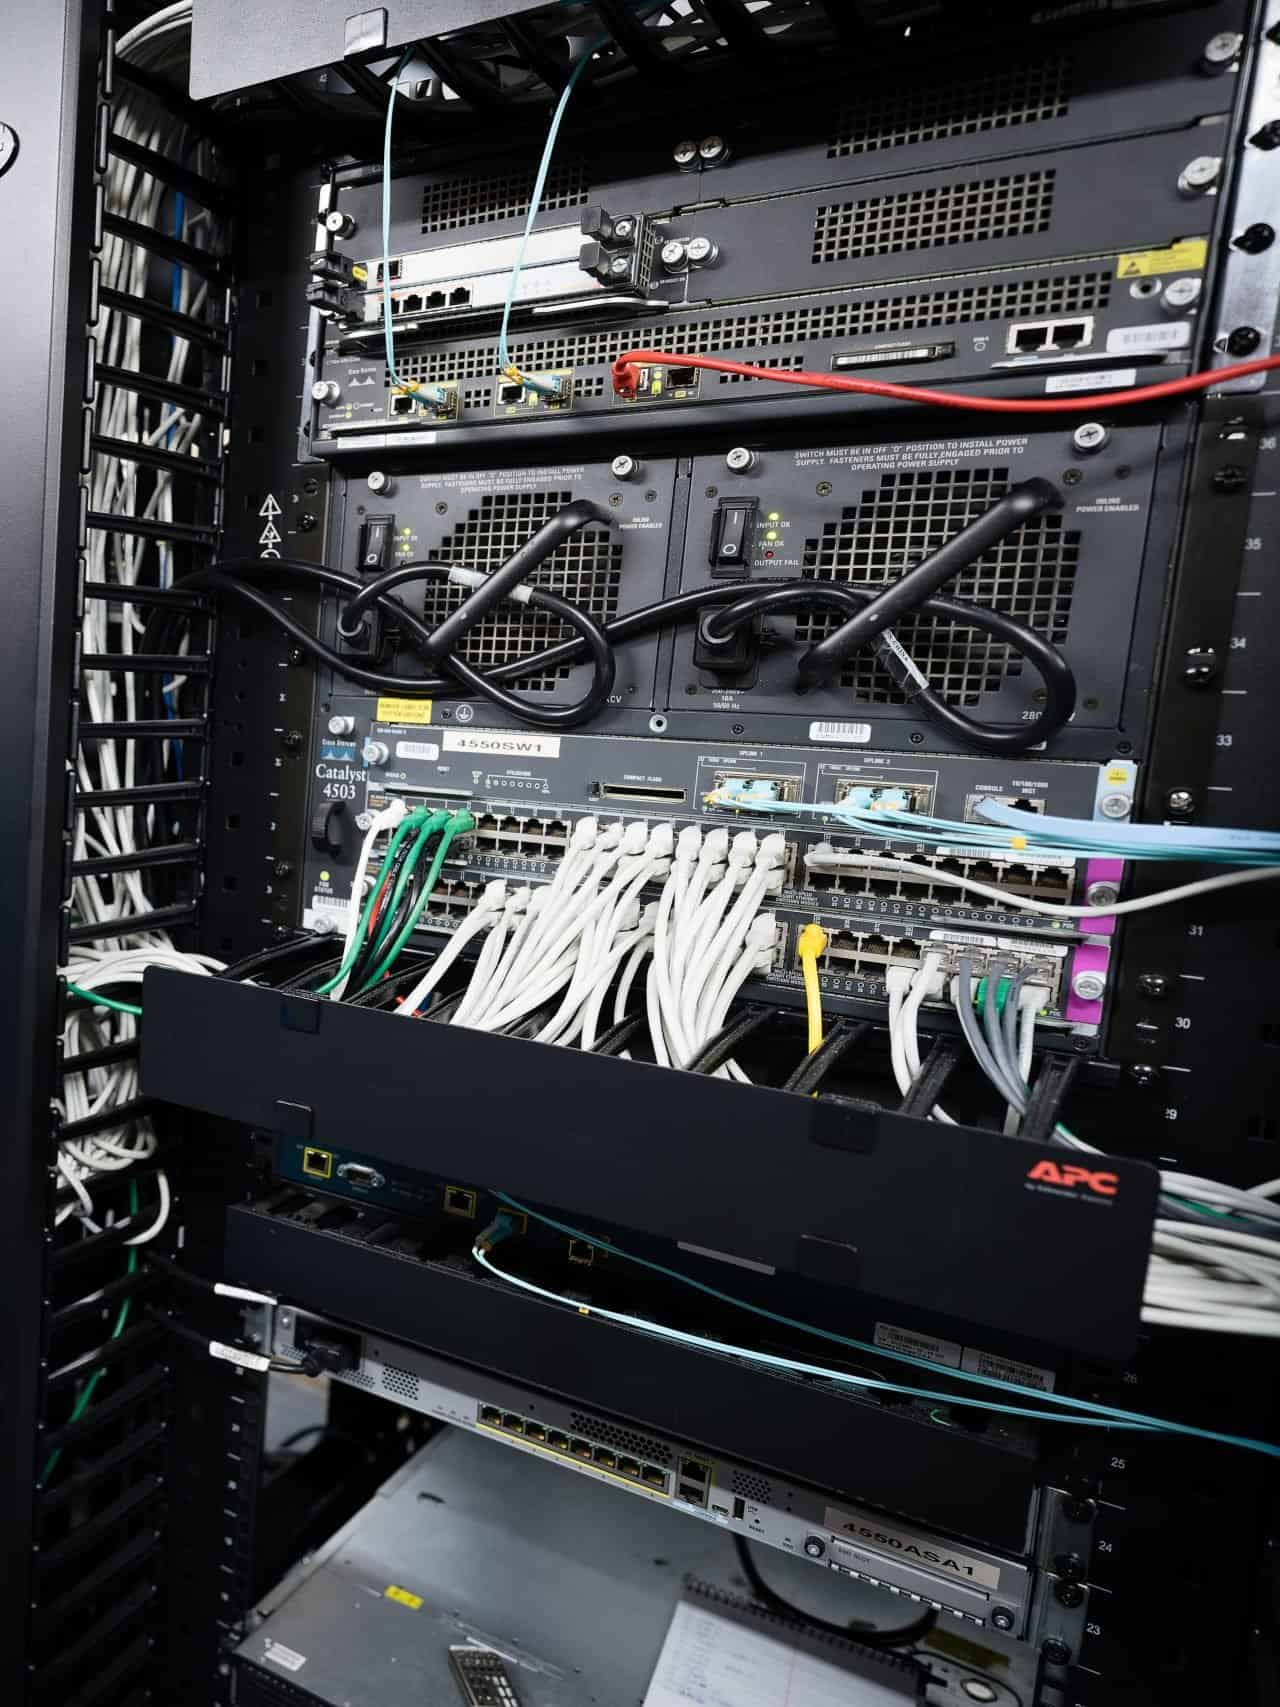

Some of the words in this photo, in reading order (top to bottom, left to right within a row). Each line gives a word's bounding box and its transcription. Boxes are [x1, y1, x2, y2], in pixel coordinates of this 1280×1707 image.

[825, 448, 849, 457] MUST
[850, 447, 860, 456] BE
[862, 447, 872, 455] IN
[905, 443, 945, 452] POSITION
[947, 442, 958, 450] TO
[959, 439, 994, 449] INSTALL
[996, 437, 1028, 447] POWER
[829, 455, 874, 465] FASTENERS
[876, 453, 900, 462] MUST
[902, 453, 913, 461] BE
[983, 447, 1010, 456] PRIOR
[1013, 446, 1025, 455] TO
[850, 461, 896, 471] OPERATING
[897, 460, 927, 469] POWER
[928, 458, 960, 468] SUPPLY
[1244, 537, 1262, 551] 35
[754, 559, 783, 568] OUTPUT
[1230, 637, 1247, 649] 34
[457, 738, 543, 753] 4550SW1
[1215, 734, 1233, 746] 33
[315, 763, 367, 784] Catalyst
[323, 783, 357, 799] 4503
[1188, 924, 1204, 937] 31
[1175, 1016, 1192, 1030] 30
[1027, 1160, 1119, 1195] APC
[1111, 1456, 1126, 1469] 25
[842, 1521, 974, 1577] 4550ASA1
[1098, 1539, 1113, 1553] 24
[1086, 1622, 1101, 1636] 23
